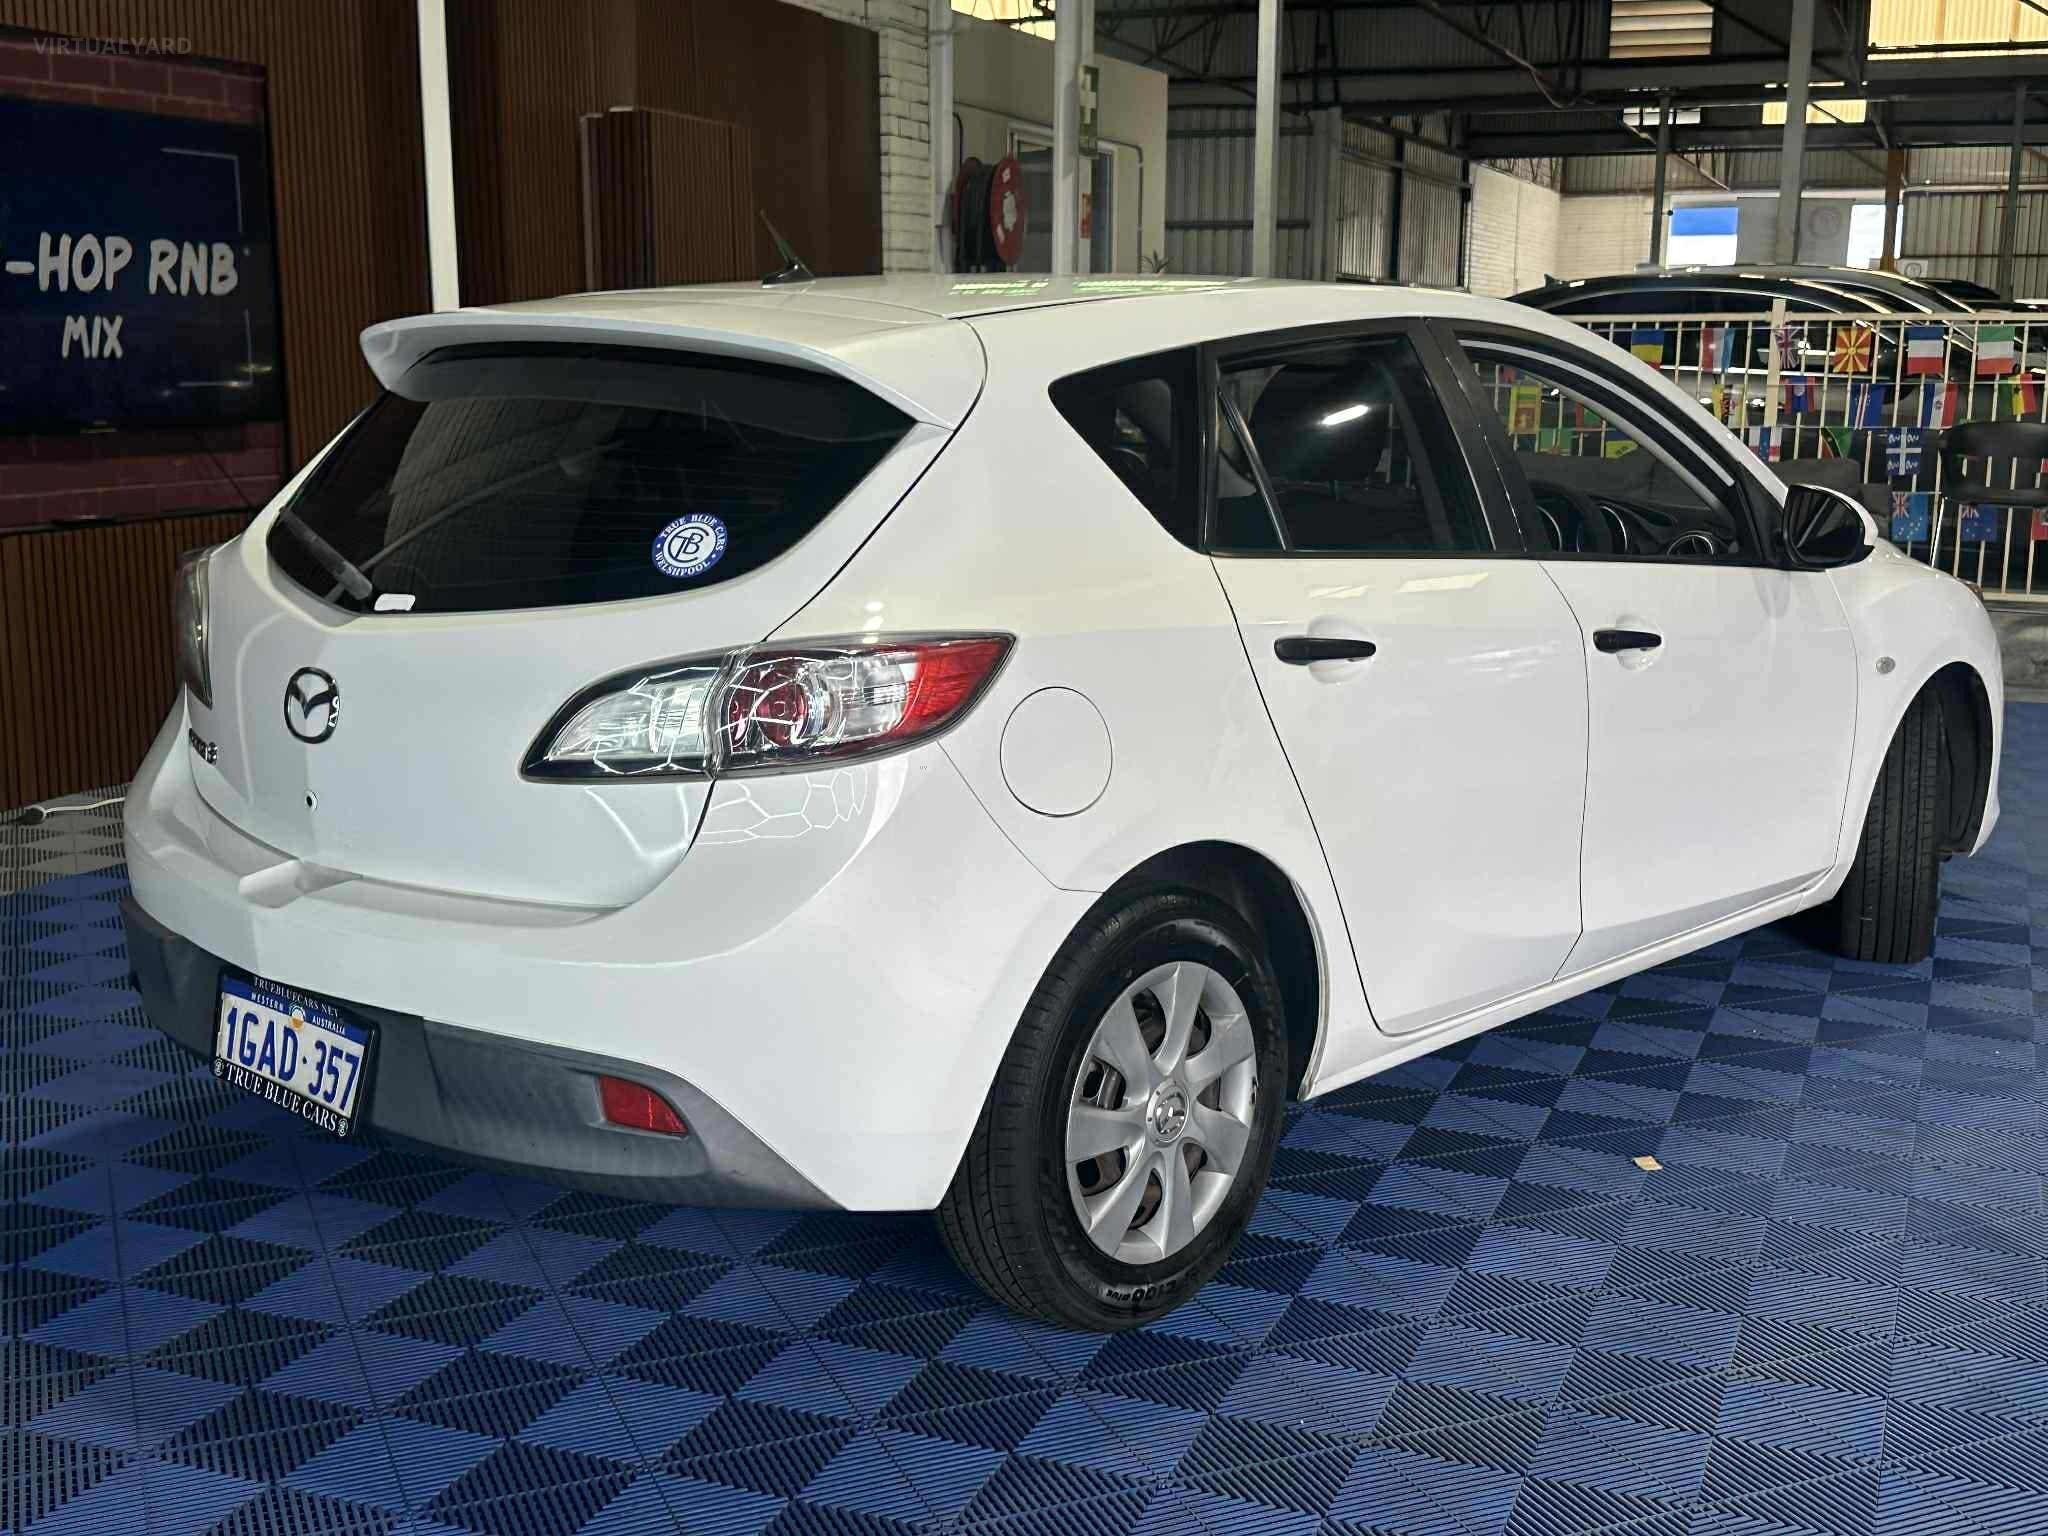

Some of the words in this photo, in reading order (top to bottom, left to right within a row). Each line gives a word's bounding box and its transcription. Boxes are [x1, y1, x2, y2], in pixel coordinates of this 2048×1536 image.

[149, 238, 239, 296] RNB
[61, 314, 124, 359] MIX
[660, 516, 687, 538] TRUE
[691, 513, 718, 527] BLUE
[714, 525, 726, 551] CARS
[655, 551, 711, 577] WELSHPOOL
[251, 992, 285, 1012] WESTERN
[311, 1014, 346, 1034] AUSTRALIA
[225, 1063, 265, 1096] TRUE
[264, 1081, 300, 1114] BLUE
[302, 1099, 338, 1132] CARS
